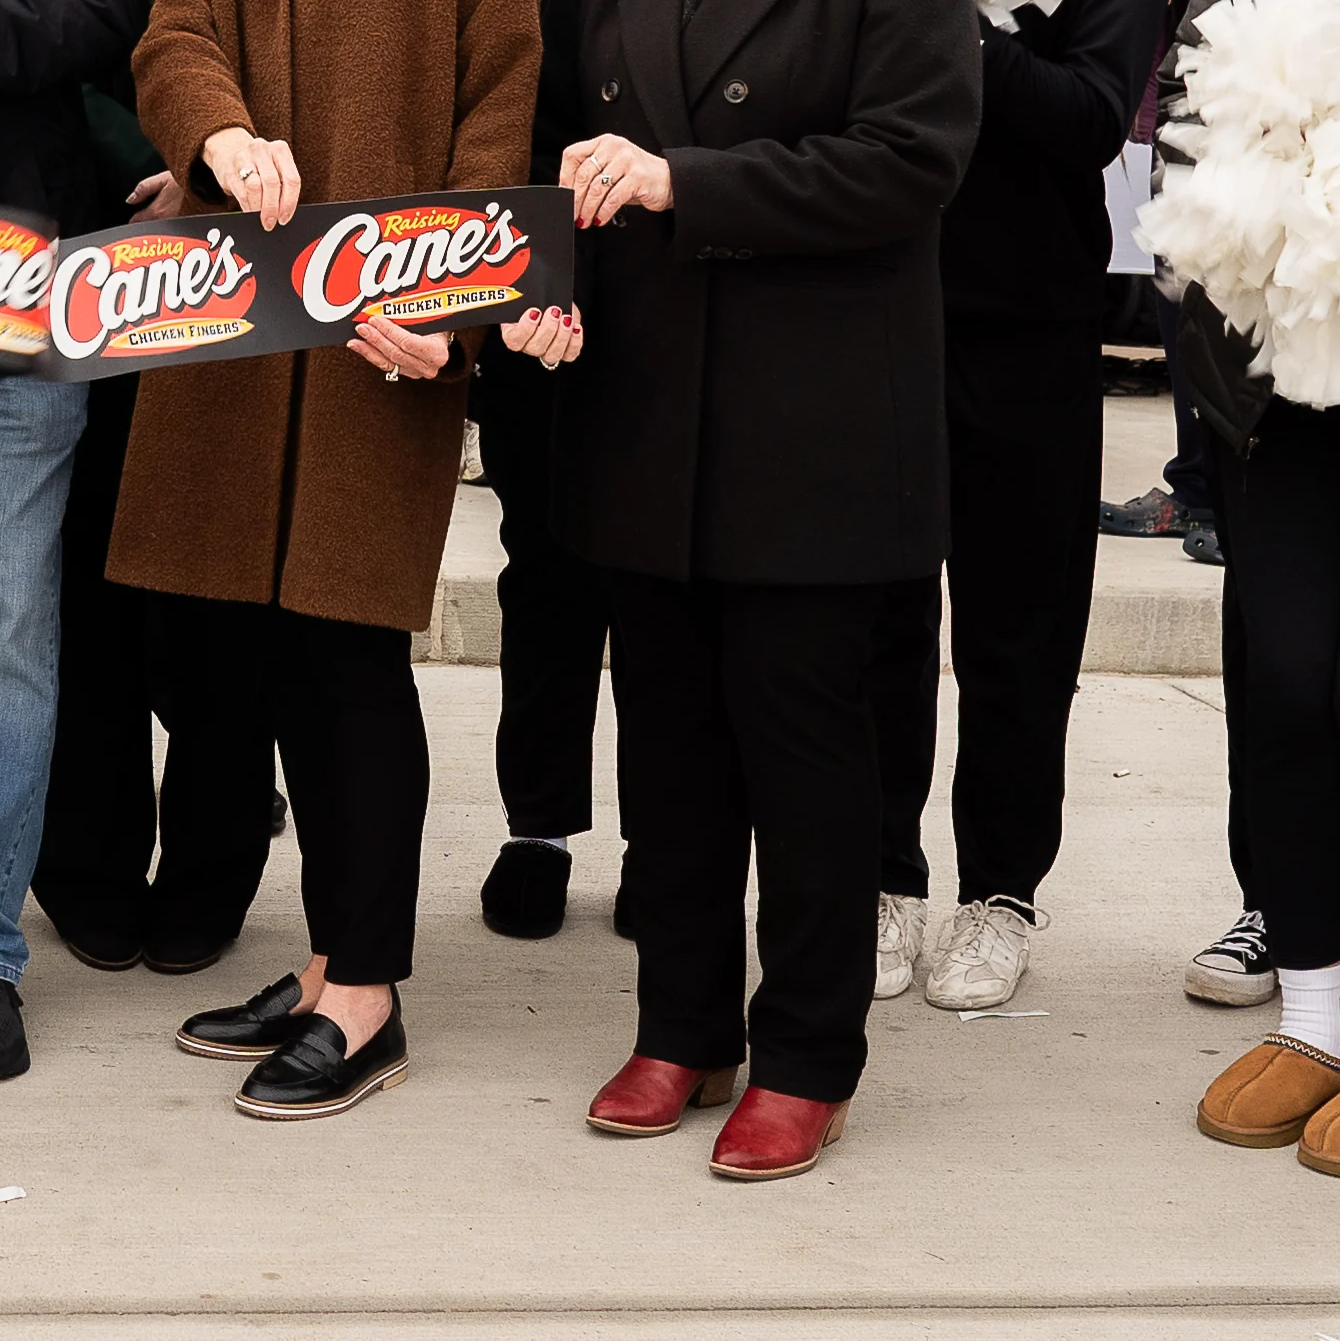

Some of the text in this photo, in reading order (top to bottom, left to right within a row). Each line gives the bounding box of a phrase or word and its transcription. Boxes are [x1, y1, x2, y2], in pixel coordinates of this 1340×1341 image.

[383, 209, 461, 237] Raising
[112, 238, 184, 267] Raising
[303, 202, 529, 322] Cane's
[50, 228, 252, 359] Cane's
[382, 289, 506, 315] CHICKEN FINGERS
[128, 322, 239, 345] CHICKEN FINGERS
